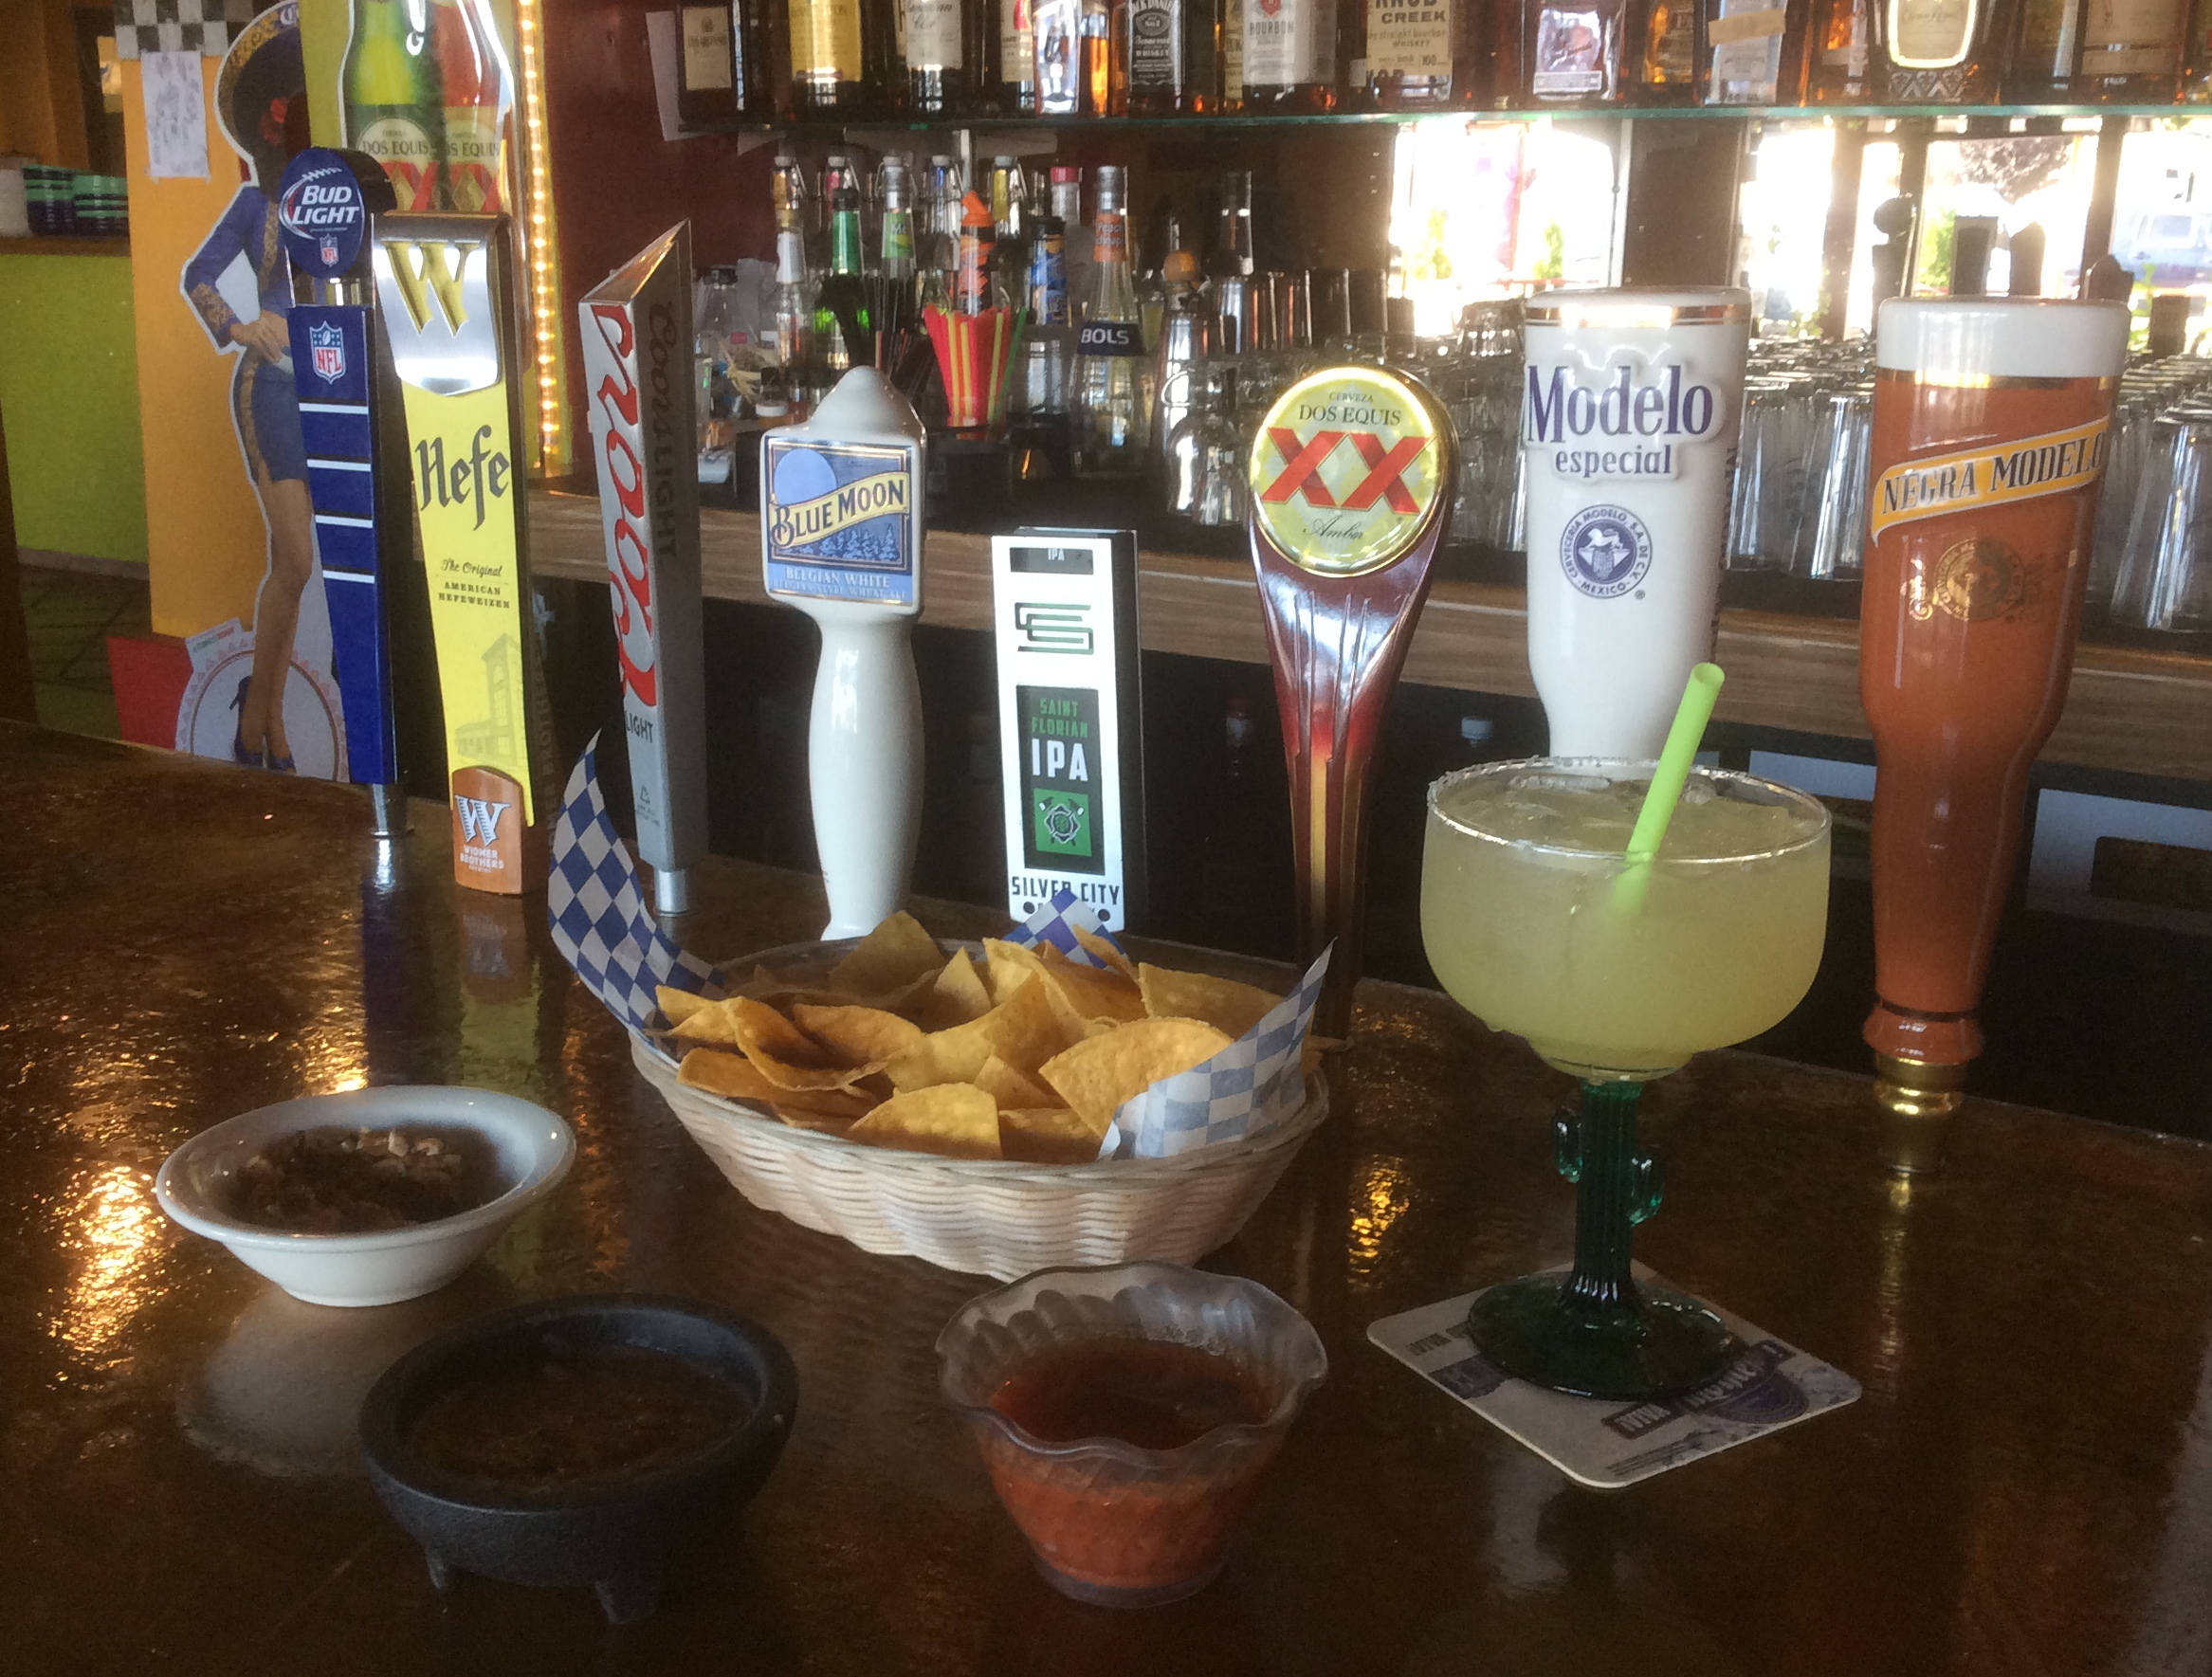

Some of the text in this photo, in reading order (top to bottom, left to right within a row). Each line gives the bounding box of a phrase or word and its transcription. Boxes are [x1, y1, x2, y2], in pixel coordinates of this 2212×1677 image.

[1381, 10, 1446, 24] CREEK
[1250, 21, 1294, 35] BOURBON
[302, 185, 352, 205] BUD
[292, 206, 359, 225] LIGHT
[381, 240, 480, 337] W
[1081, 329, 1129, 345] BOLS
[315, 348, 345, 376] NFL
[649, 301, 677, 437] Coors
[1328, 392, 1374, 403] CERVEZA
[1528, 365, 1713, 443] Modelo
[1299, 404, 1401, 426] DOS EQUIS
[1262, 427, 1435, 516] XX
[1556, 445, 1671, 478] especial
[415, 425, 510, 531] Hefe
[1882, 432, 2107, 514] NEGRA MODELO
[654, 447, 676, 558] LIGHT
[771, 480, 905, 547] BLUE MOON
[1048, 548, 1065, 561] IPA
[441, 558, 503, 578] The Original
[786, 567, 889, 588] BELGIAN WHITE
[445, 581, 501, 595] AMERICAN
[438, 592, 509, 609] HEFEWEIZEN
[1039, 698, 1078, 717] SAINT
[626, 713, 653, 743] LIGHT
[1031, 717, 1088, 738] FLORIAN
[1032, 738, 1088, 781] IPA
[455, 794, 510, 847] W
[464, 845, 498, 859] WIDMER
[1081, 883, 1120, 904] CITY
